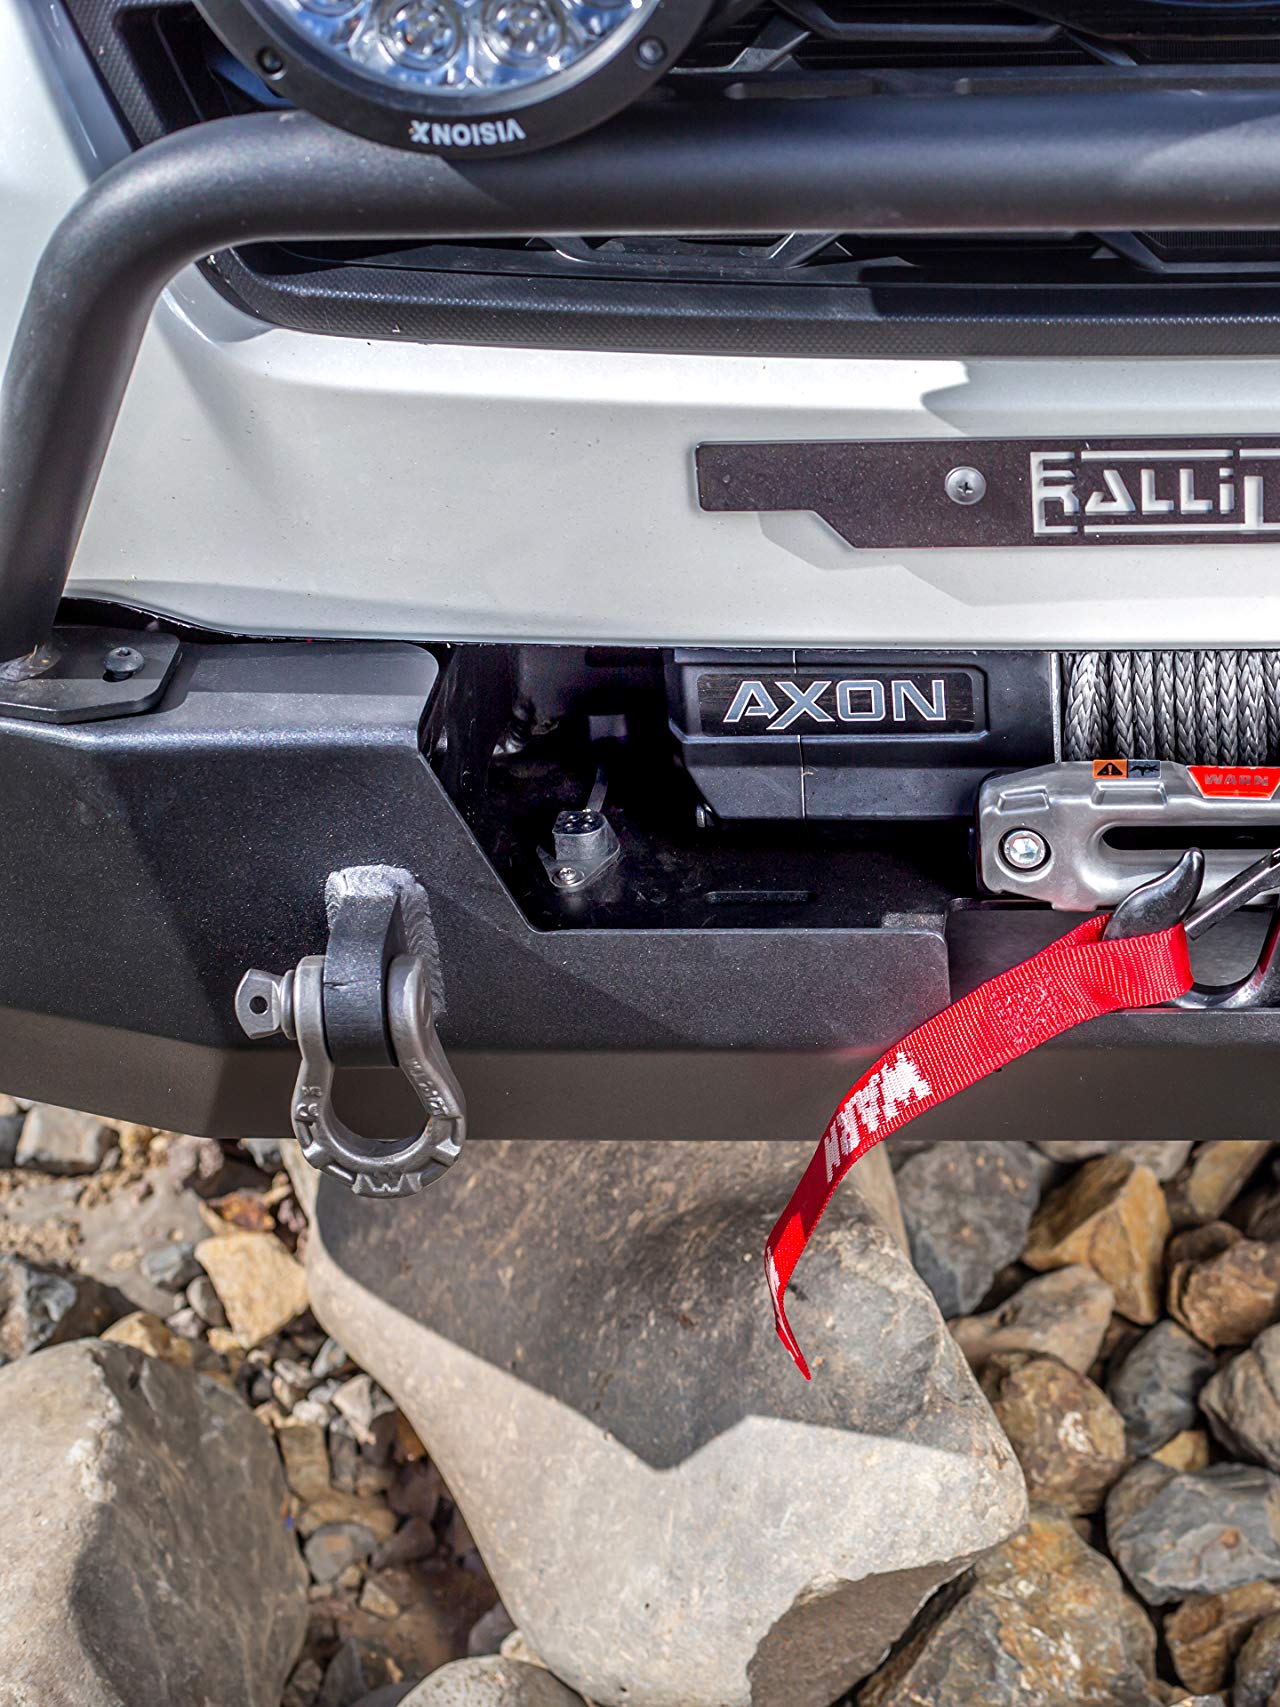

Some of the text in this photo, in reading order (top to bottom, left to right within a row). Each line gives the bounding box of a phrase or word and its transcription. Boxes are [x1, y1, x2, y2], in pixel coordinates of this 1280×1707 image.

[410, 118, 527, 147] VISIONX
[723, 679, 947, 731] AXON
[1204, 773, 1269, 787] WARN
